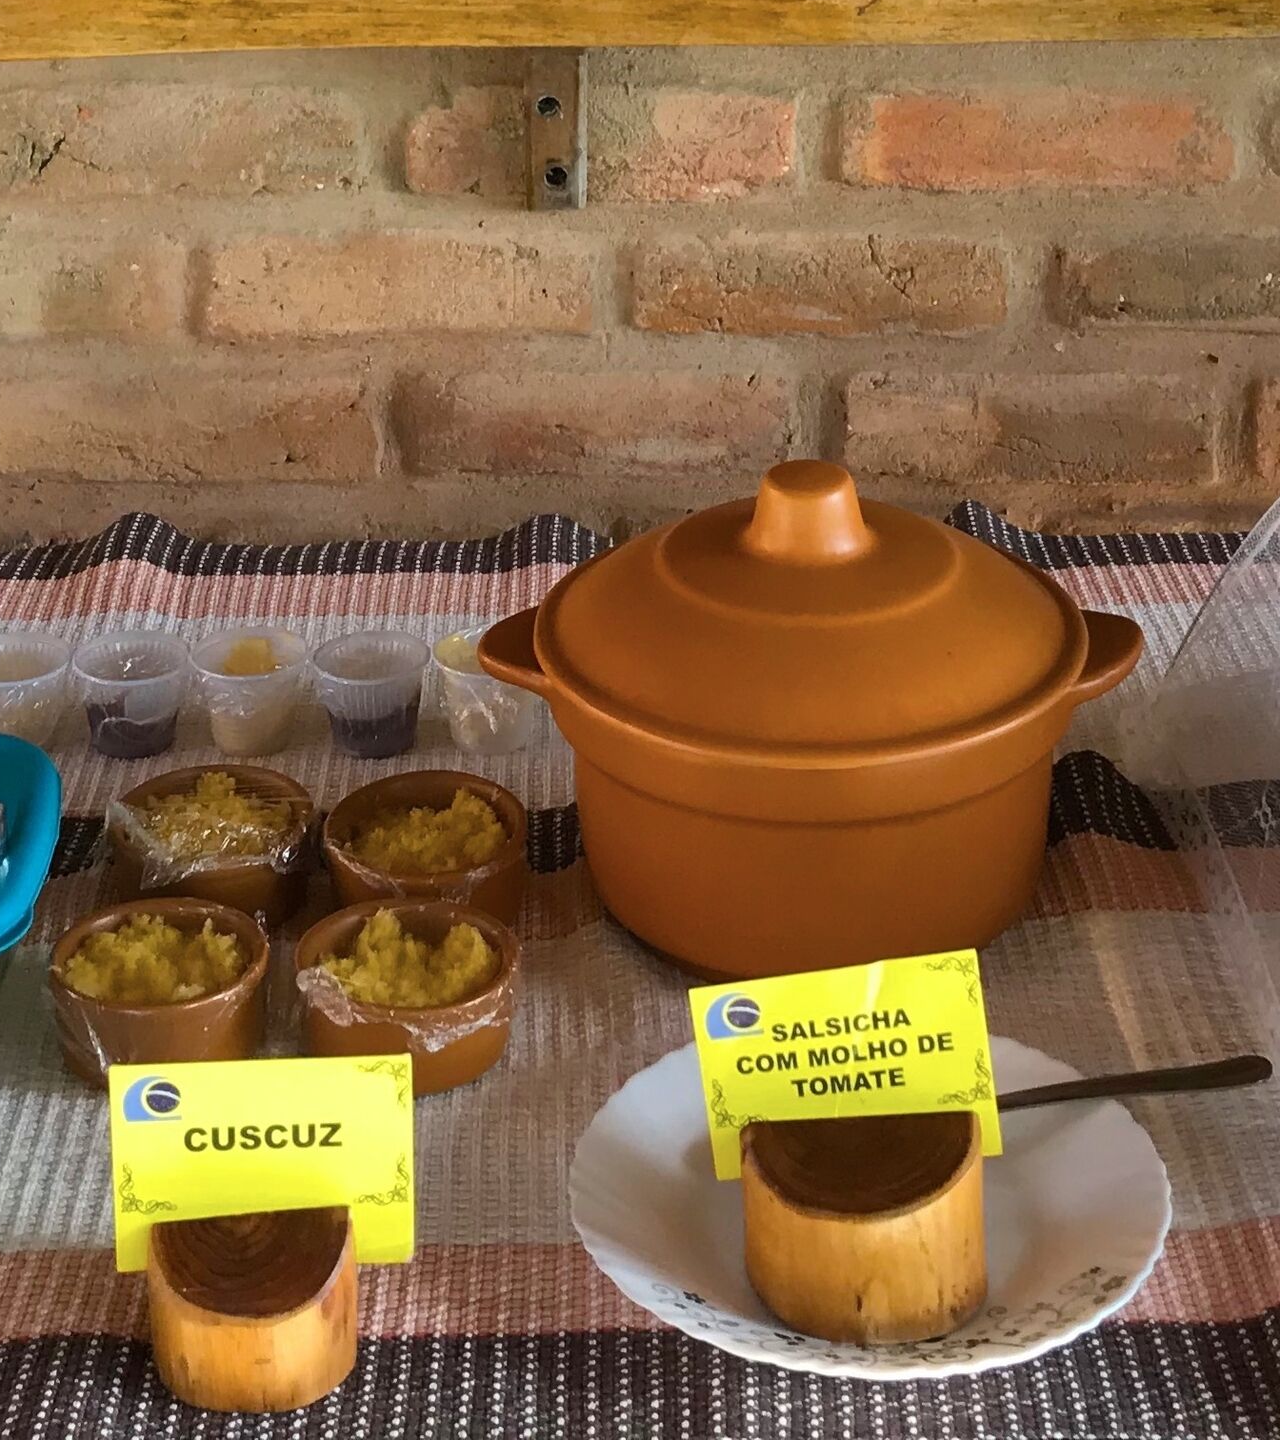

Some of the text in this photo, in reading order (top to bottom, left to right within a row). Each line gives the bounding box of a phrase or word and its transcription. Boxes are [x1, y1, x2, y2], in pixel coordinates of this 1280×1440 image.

[771, 1009, 911, 1042] SALSICHA
[736, 1032, 954, 1075] COM MOLHO DE
[791, 1067, 906, 1098] TOMATE
[184, 1122, 343, 1152] CUSCUZ
